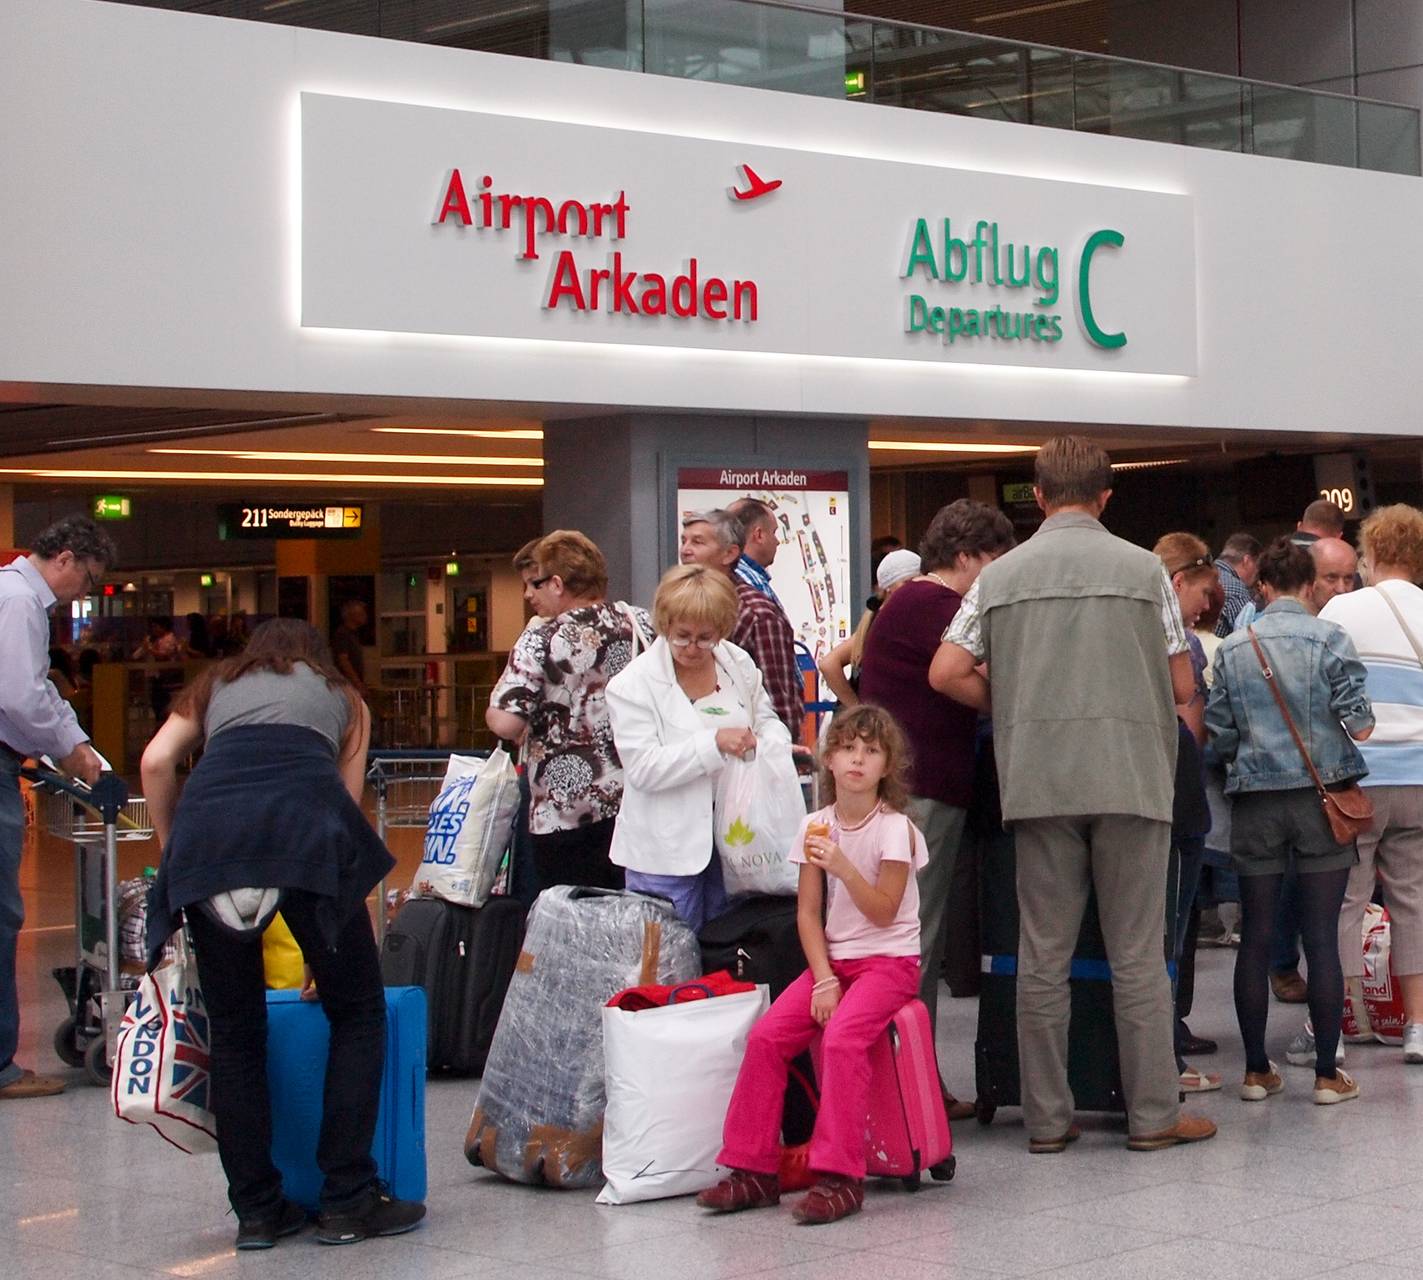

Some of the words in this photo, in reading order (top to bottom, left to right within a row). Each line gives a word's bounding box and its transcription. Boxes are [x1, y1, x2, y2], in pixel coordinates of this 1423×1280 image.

[432, 168, 630, 260] Airport
[542, 250, 758, 322] Arkaden
[899, 217, 1060, 307] Abflug
[1073, 229, 1128, 350] C
[904, 294, 1063, 345] Departures
[719, 469, 759, 488] Airport
[761, 470, 807, 486] Arkaden
[241, 508, 268, 527] 211
[268, 507, 324, 520] Sondergepäck
[741, 851, 782, 868] NOVA
